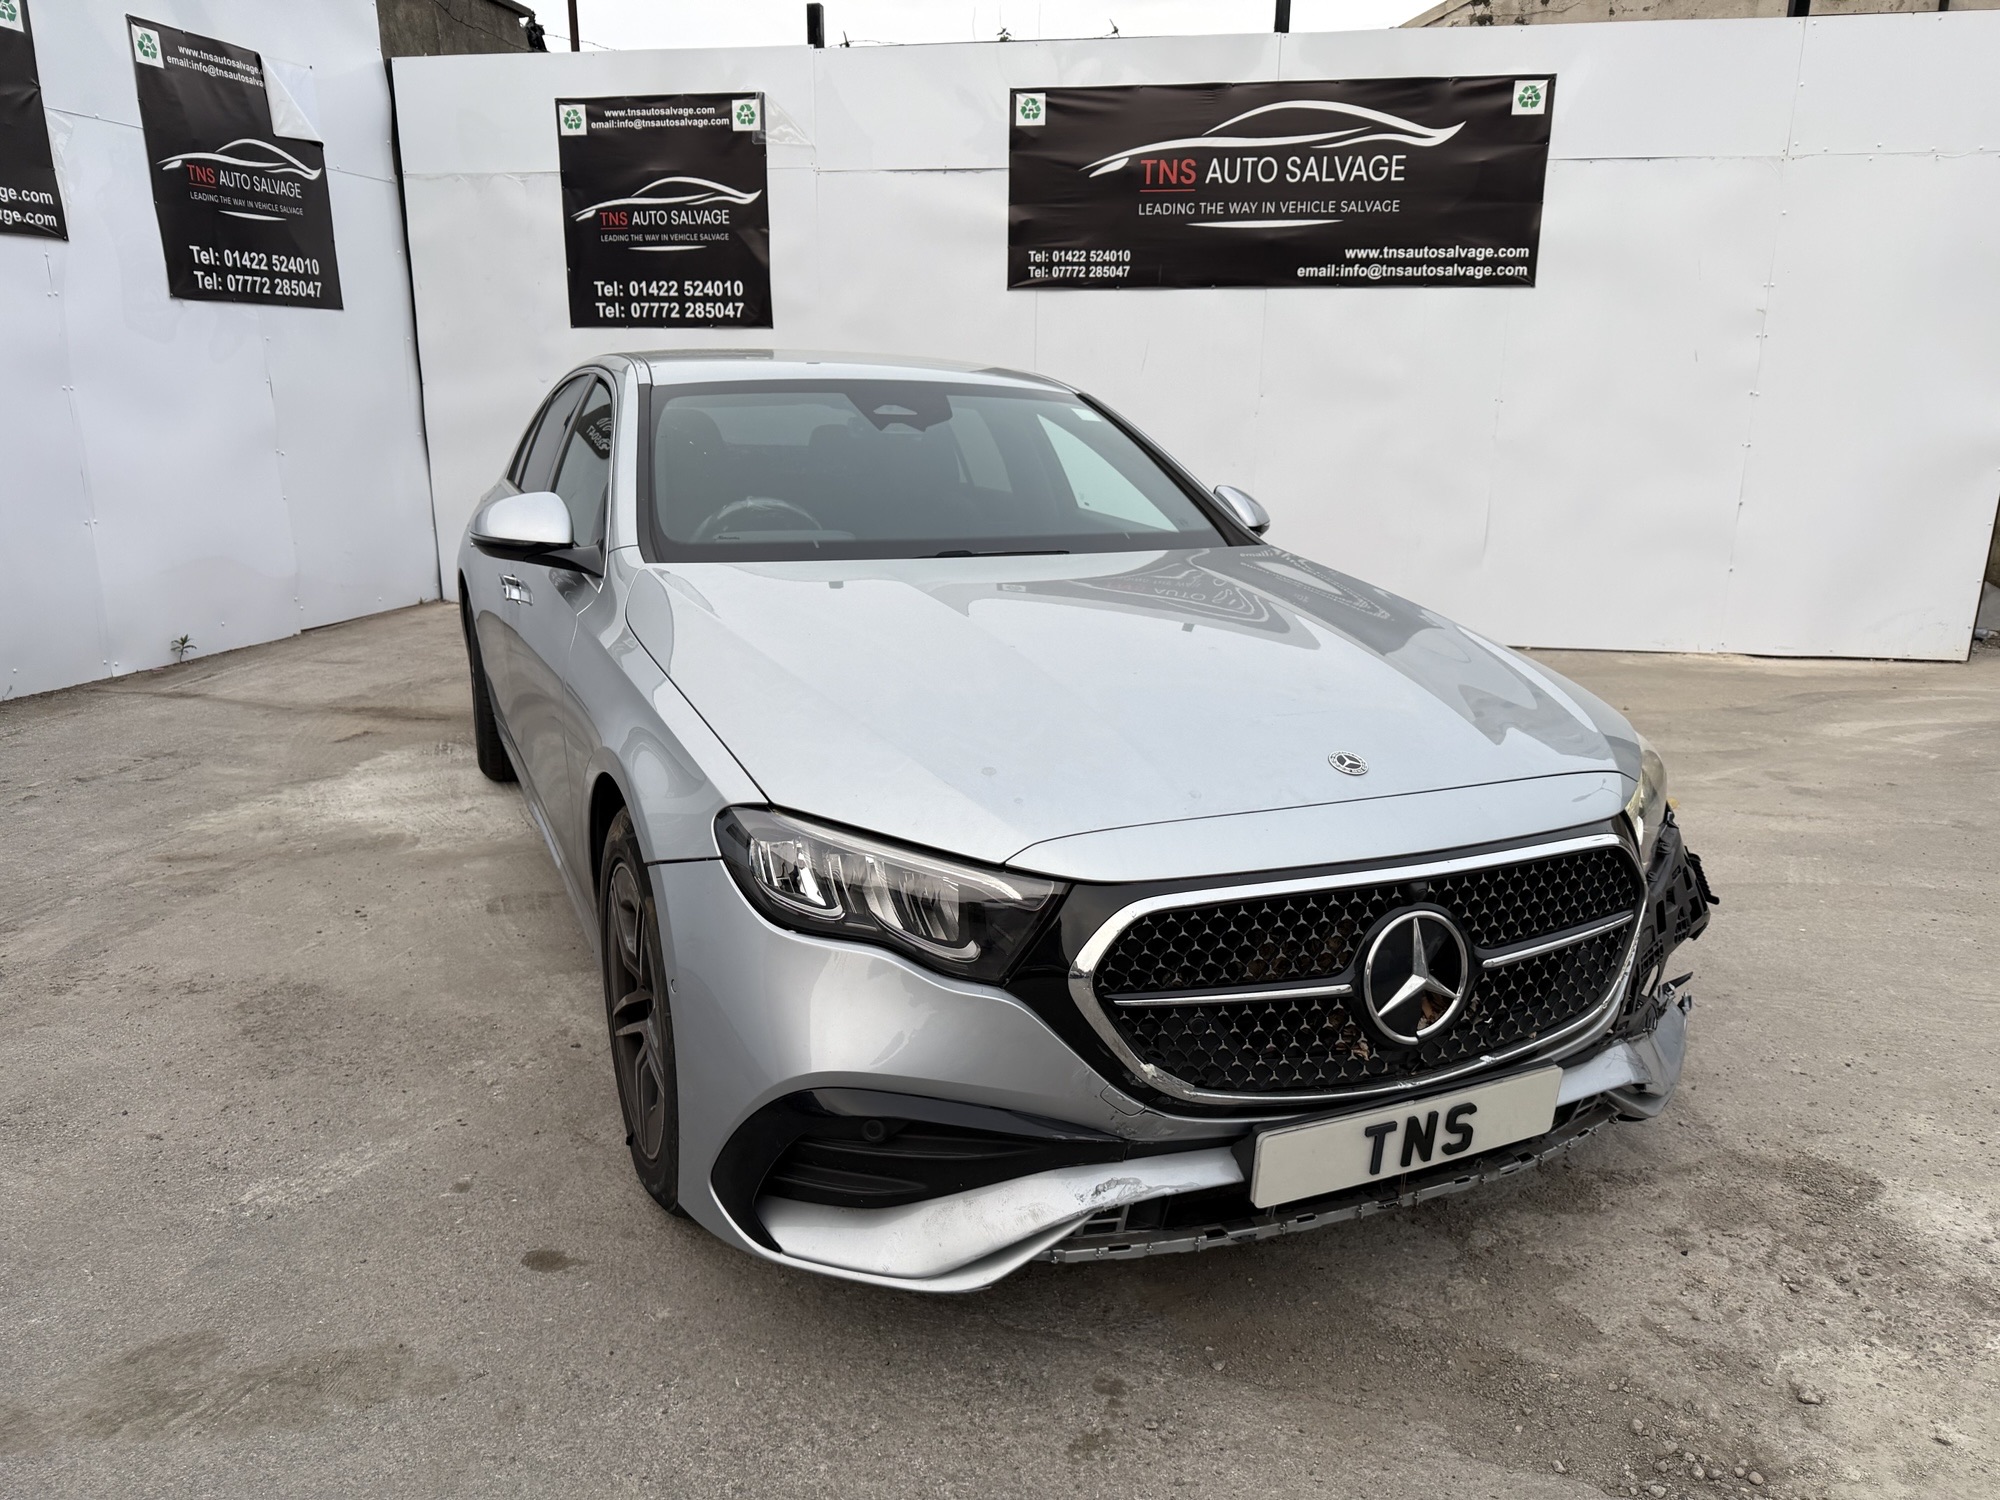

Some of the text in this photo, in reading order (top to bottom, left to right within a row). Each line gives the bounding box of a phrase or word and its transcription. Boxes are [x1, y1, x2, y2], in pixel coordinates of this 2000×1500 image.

[604, 106, 715, 118] www.tnsautosalvage.com
[591, 117, 730, 130] email:info@tnsautosalvage.com
[1140, 155, 1406, 184] TNS AUTO SALVAGE
[186, 164, 302, 199] TNS AUTO SALVAGE
[190, 191, 304, 216] LEADING THE WAY IN VEHICLE SALVAGE
[1138, 200, 1400, 216] LEADING THE WAY IN VEHICLE SALVAGE
[600, 209, 730, 226] TNS AUTO SALVAGE
[630, 234, 644, 242] THE
[669, 233, 698, 241] VEHICLE
[699, 233, 729, 241] SALVAGE
[189, 246, 320, 276] Tel: 01422 524010
[1028, 250, 1131, 262] Tel: 01422 524010
[1345, 245, 1529, 261] www.tnsautosalvage.com
[1028, 266, 1130, 278] Tel: 07772 285047
[1297, 263, 1528, 279] email:info@tnsautosalvage.com
[193, 271, 322, 298] Tel: 07772 285047
[593, 280, 743, 296] Tel: 01422 524010
[595, 302, 744, 318] Tel: 07772 285047
[1365, 1102, 1477, 1176] TNS
